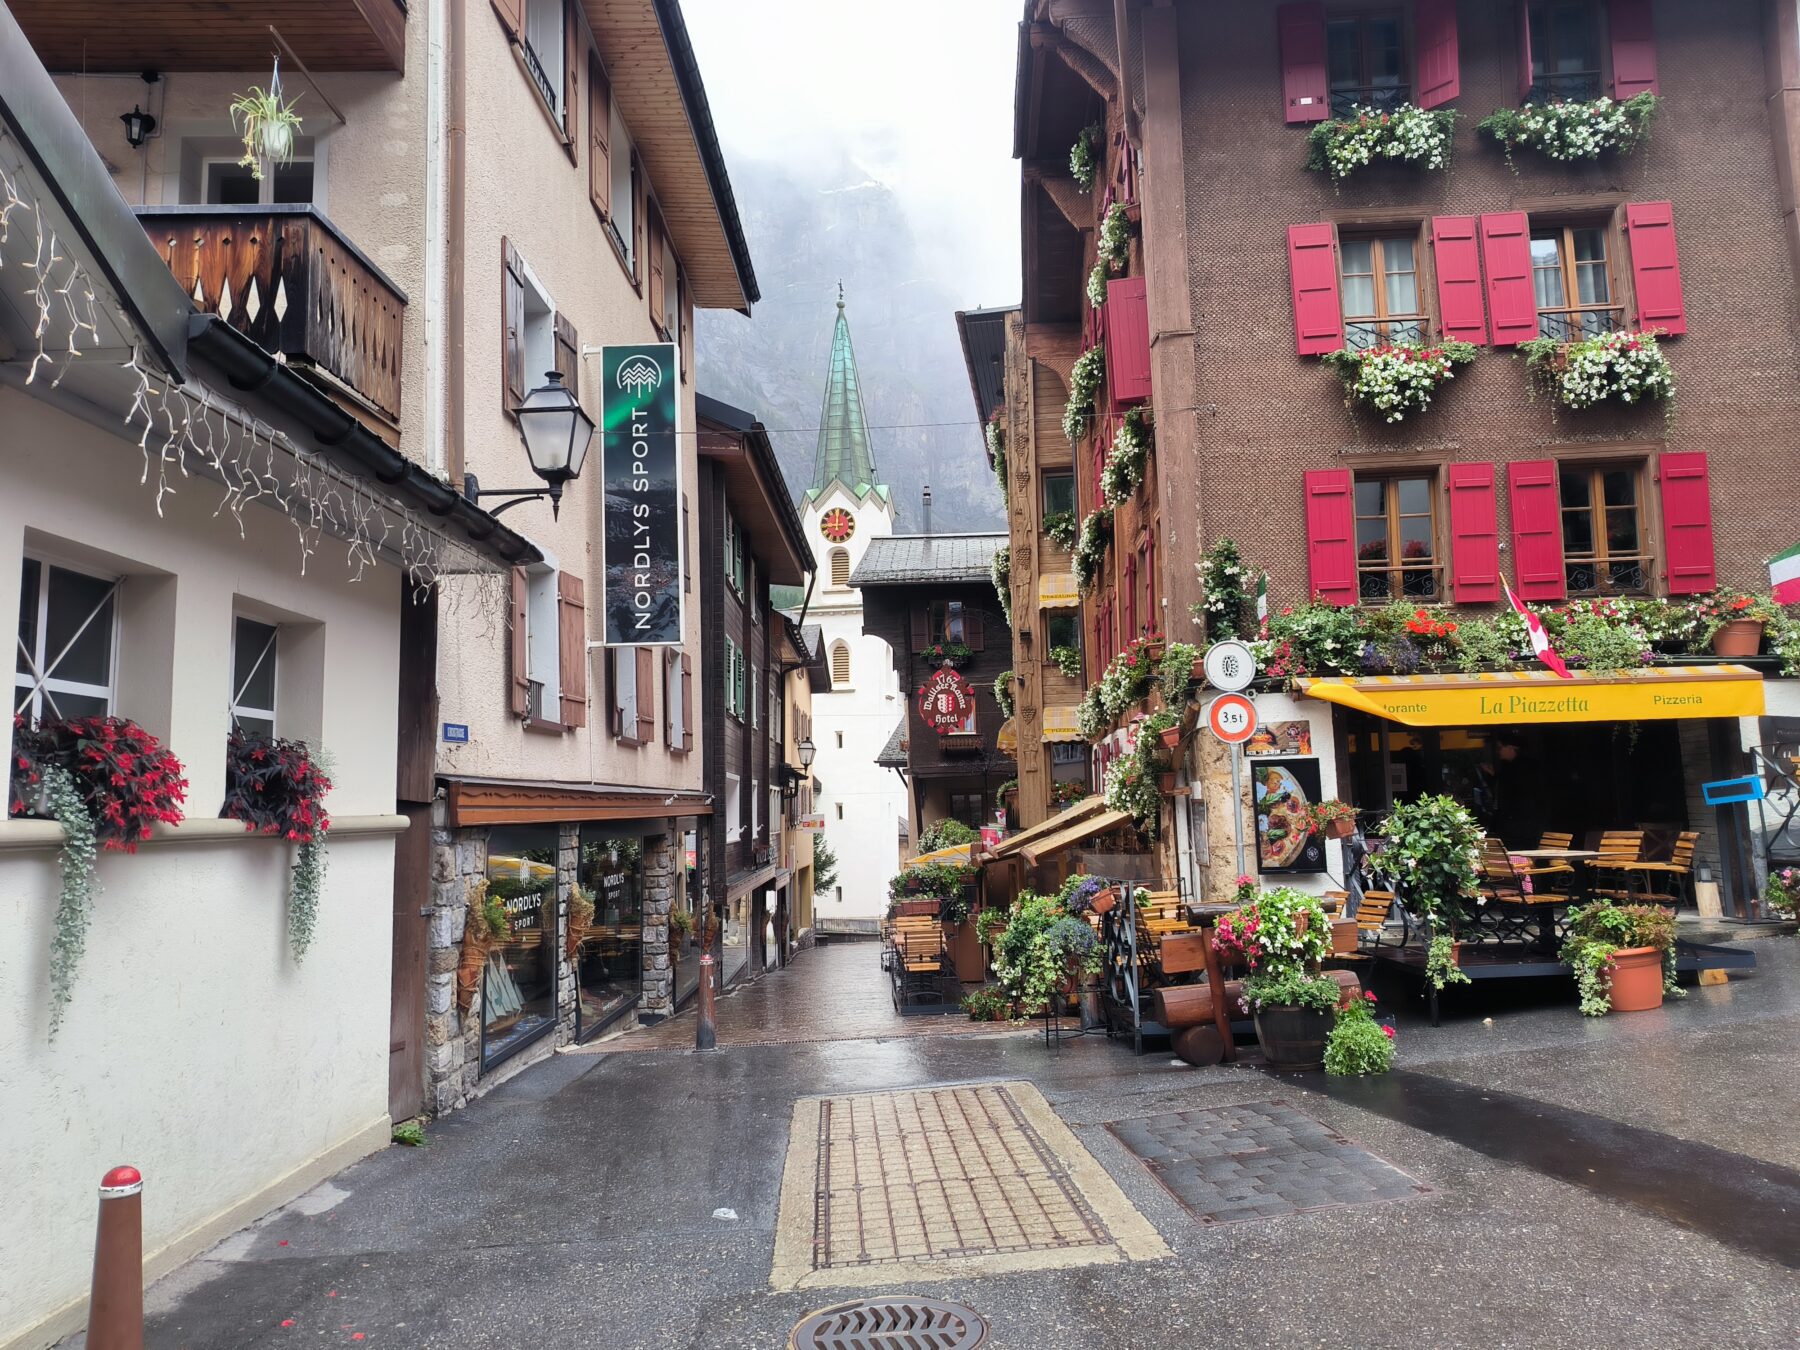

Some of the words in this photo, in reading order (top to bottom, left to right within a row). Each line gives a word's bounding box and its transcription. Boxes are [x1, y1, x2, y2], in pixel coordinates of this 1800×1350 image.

[632, 408, 648, 492] SPORT
[633, 505, 651, 629] NORDLYS
[1383, 703, 1428, 714] torante
[1480, 696, 1504, 715] La
[1509, 695, 1590, 714] Piazzetta
[1653, 694, 1703, 705] Pizzeria
[935, 714, 959, 726] Hotel
[604, 873, 625, 888] NORDLYS
[506, 893, 541, 913] NORDLYS
[608, 890, 620, 899] SPORT
[514, 916, 534, 930] SPORT
